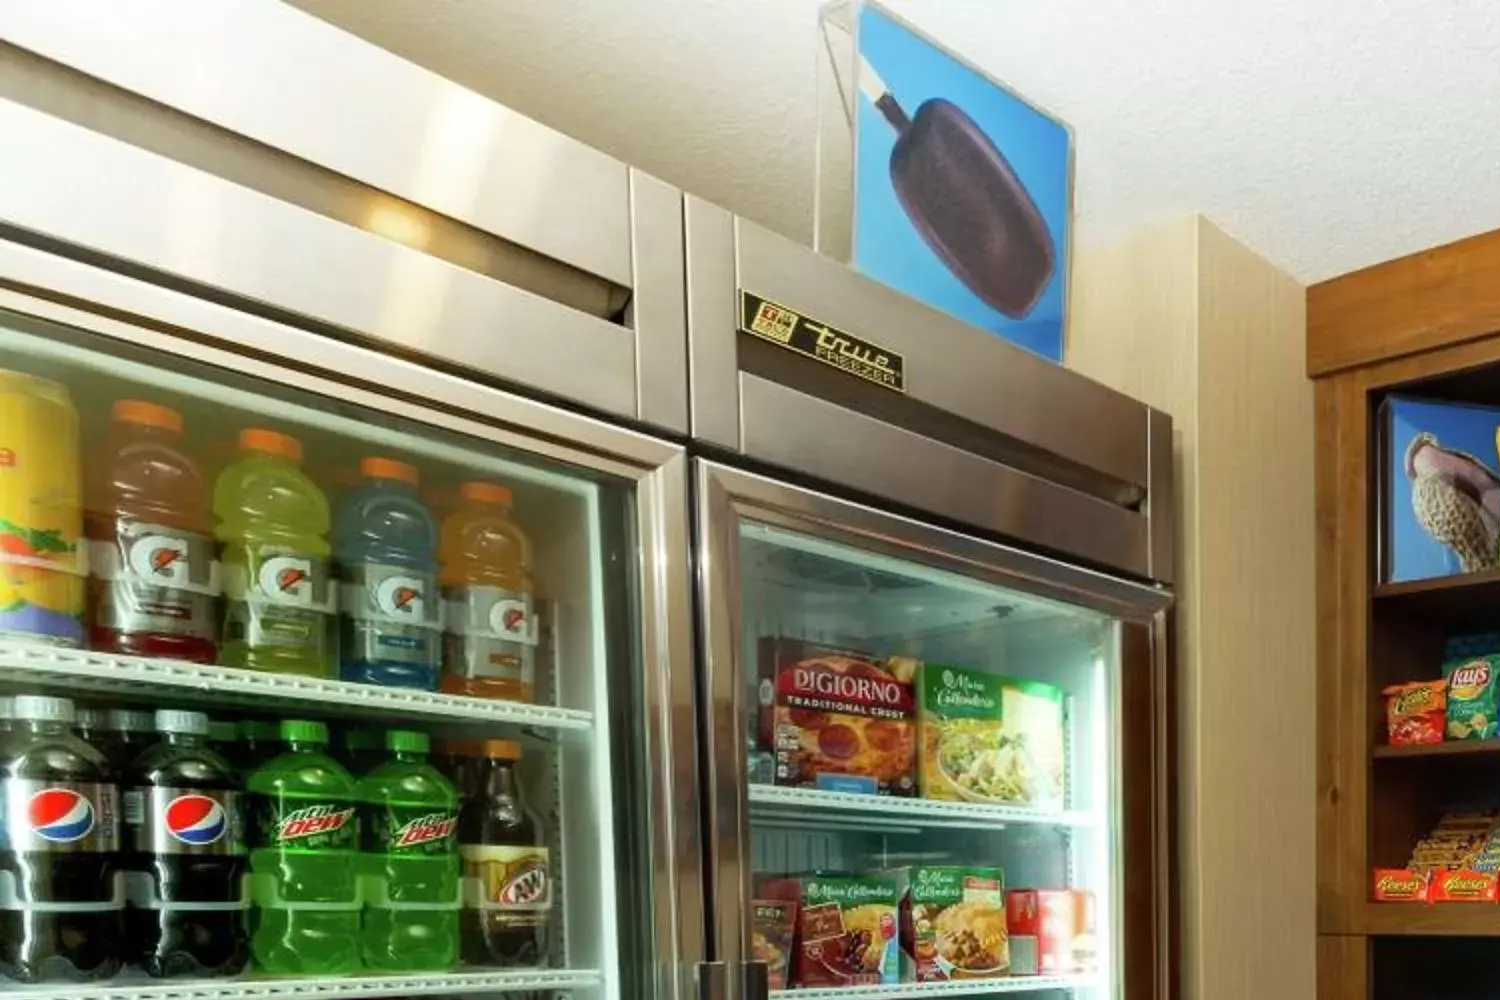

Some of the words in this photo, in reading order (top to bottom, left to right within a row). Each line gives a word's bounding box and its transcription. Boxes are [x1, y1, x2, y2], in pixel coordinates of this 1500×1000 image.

[816, 345, 895, 385] FREEZER
[787, 695, 867, 715] TRADITIONAL
[871, 706, 905, 719] CRUST
